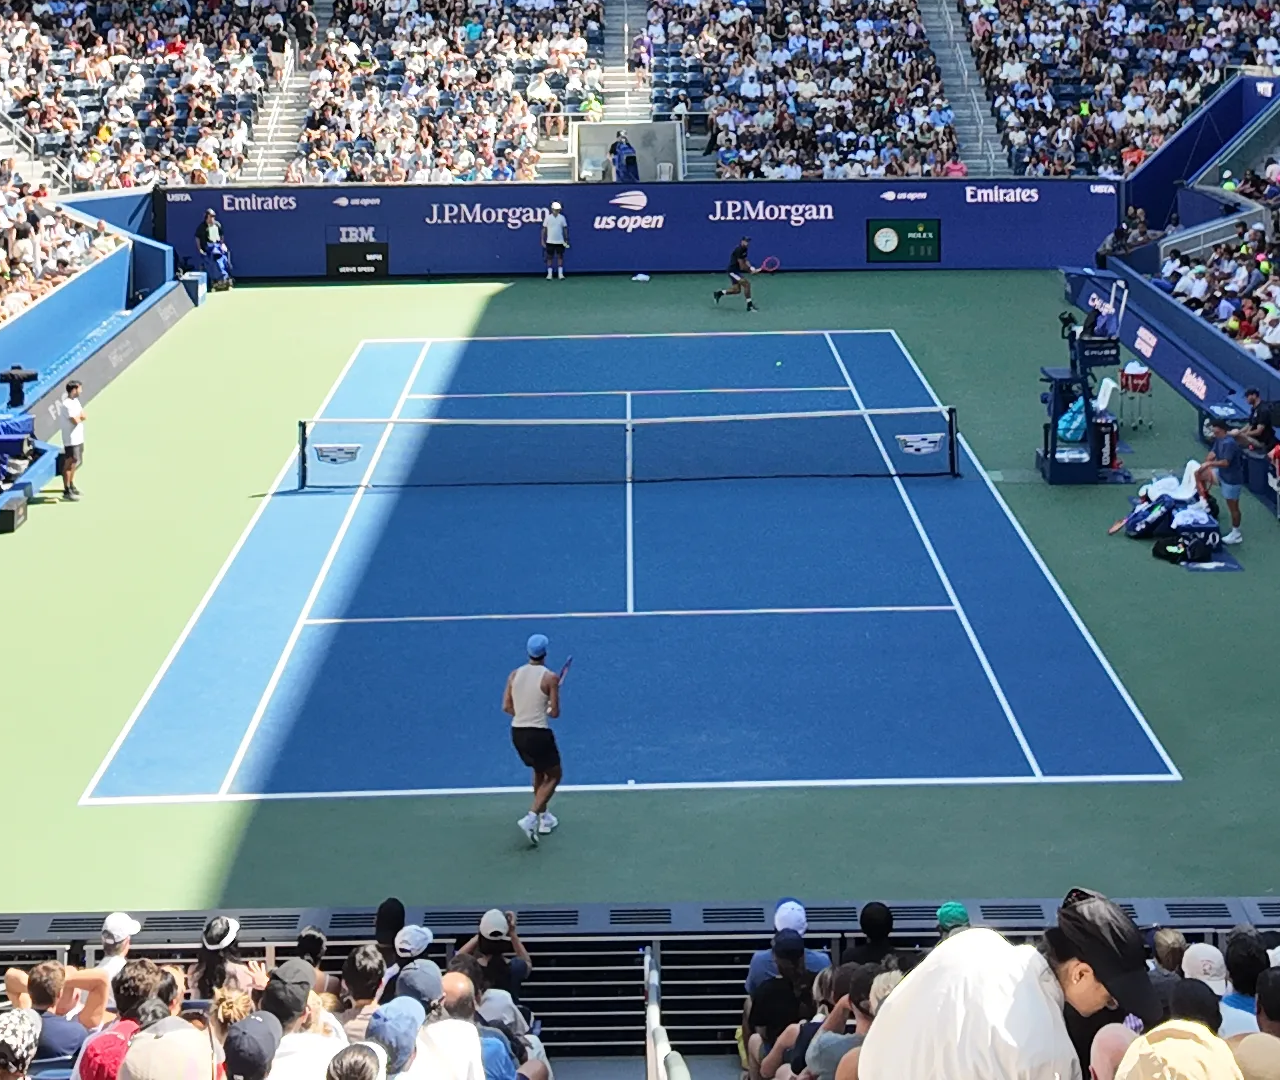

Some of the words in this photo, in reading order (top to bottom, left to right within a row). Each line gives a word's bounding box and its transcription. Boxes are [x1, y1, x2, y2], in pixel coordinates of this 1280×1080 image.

[166, 193, 192, 202] USTA
[965, 185, 1039, 203] Emirates
[1090, 184, 1116, 194] USTA
[222, 193, 297, 211] Emirates
[425, 203, 550, 229] J.P.Morgan
[708, 200, 835, 227] J.P.Morgan
[593, 215, 617, 229] us
[617, 215, 664, 233] open
[339, 226, 377, 243] IBM
